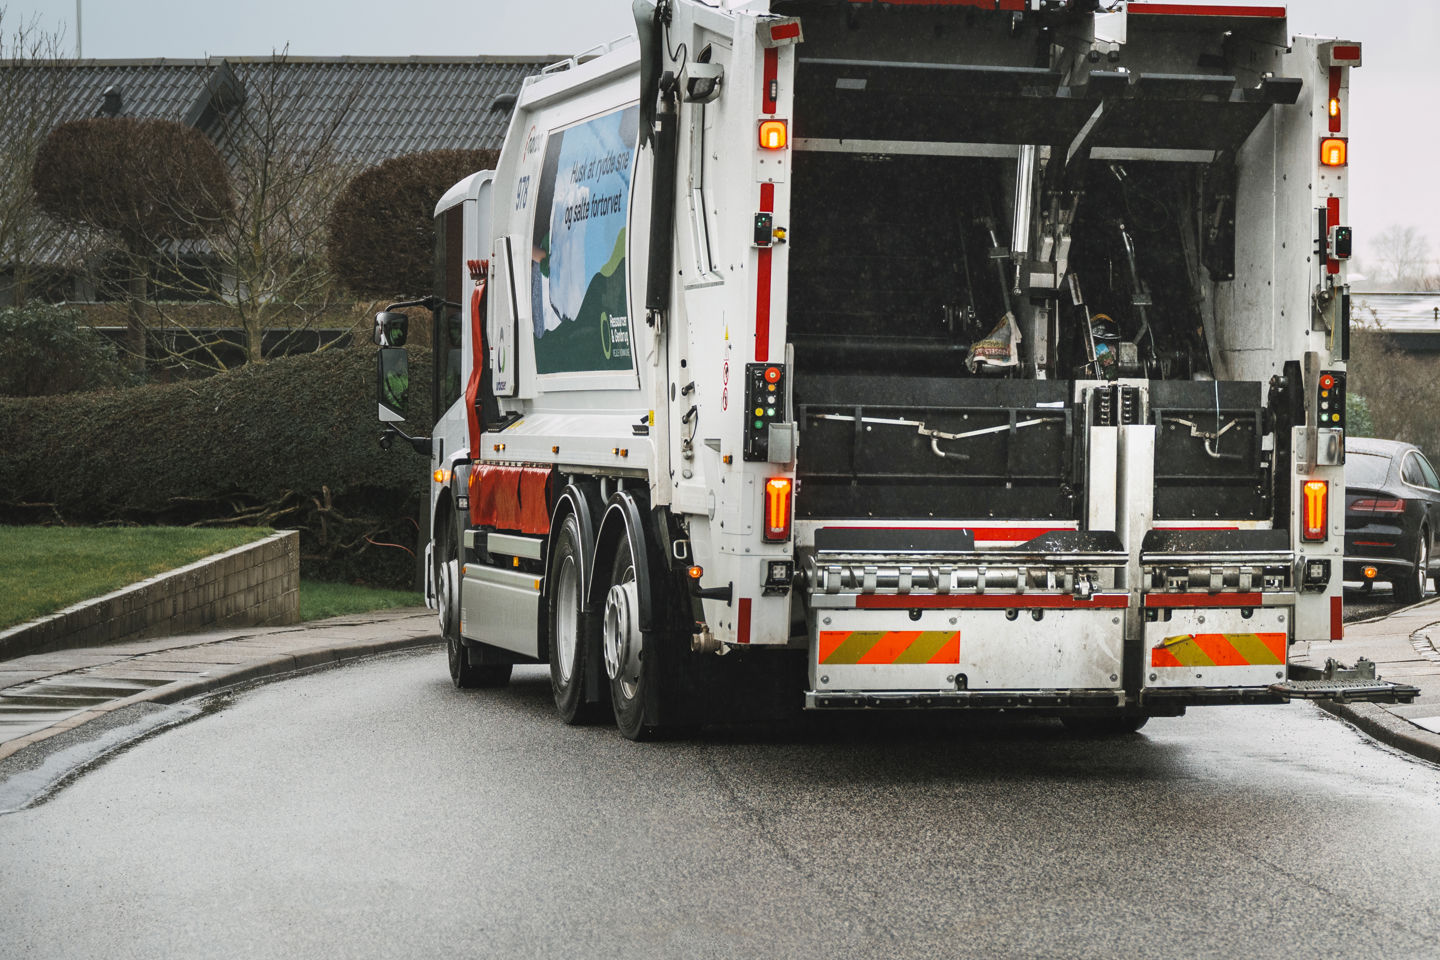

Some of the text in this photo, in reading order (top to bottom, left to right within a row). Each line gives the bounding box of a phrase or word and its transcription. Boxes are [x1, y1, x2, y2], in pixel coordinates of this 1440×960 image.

[570, 149, 630, 184] Husk at rydde sne
[516, 174, 530, 211] 978
[565, 189, 622, 230] og salte fortorvet
